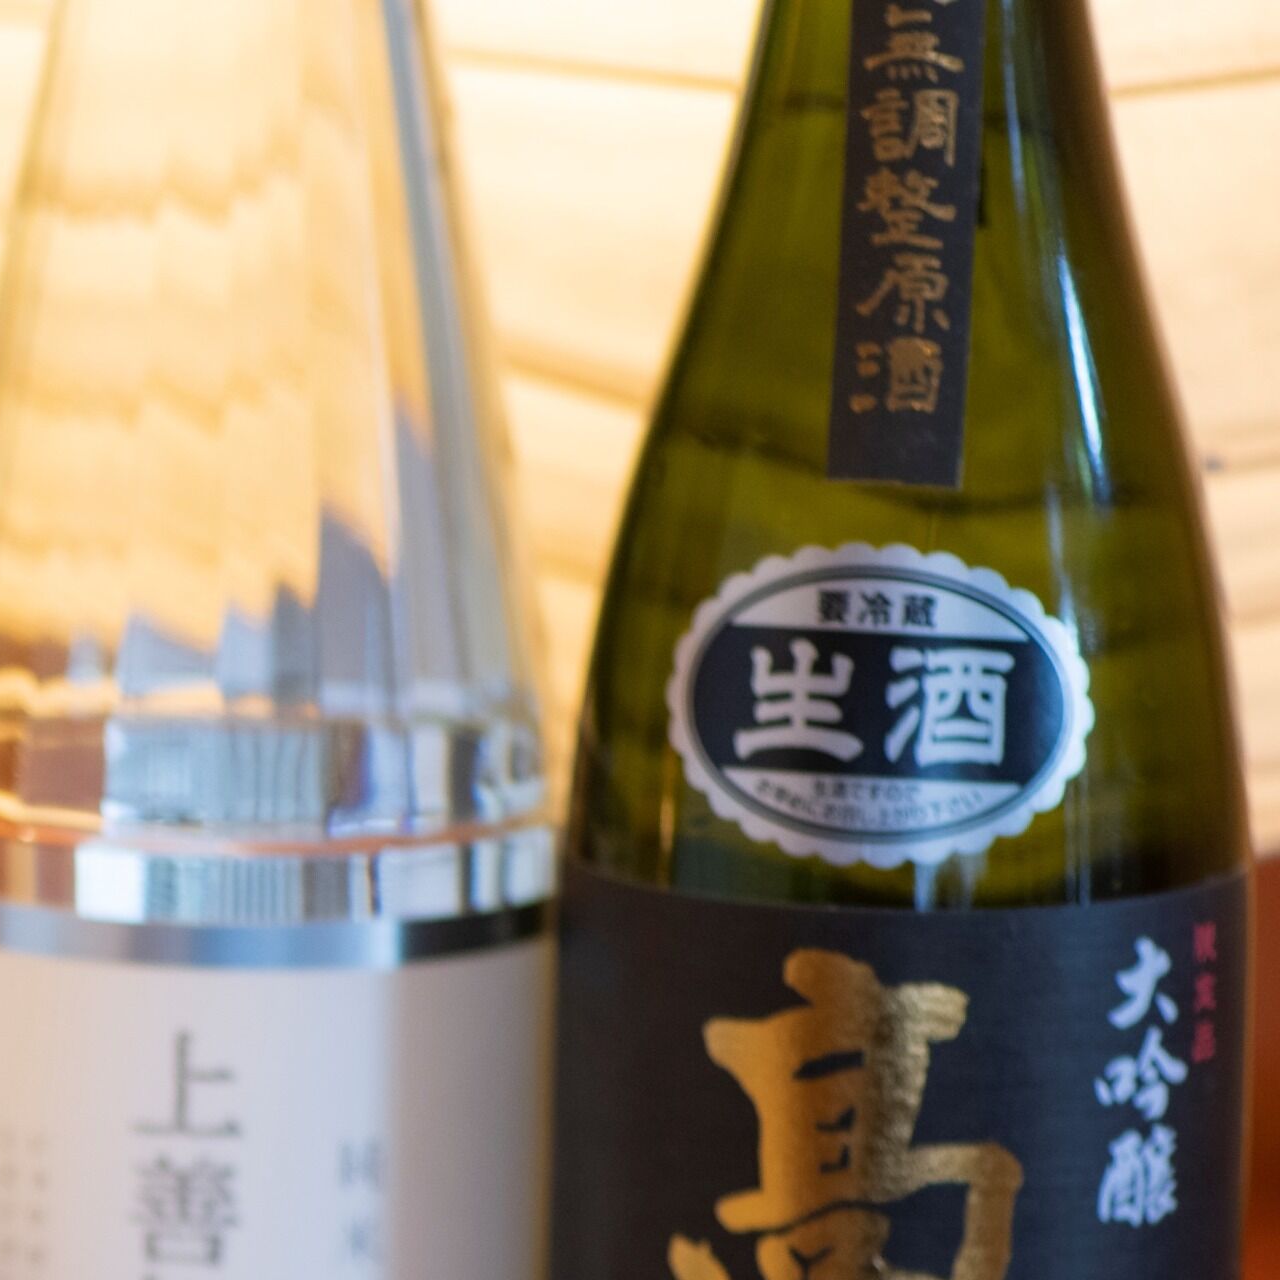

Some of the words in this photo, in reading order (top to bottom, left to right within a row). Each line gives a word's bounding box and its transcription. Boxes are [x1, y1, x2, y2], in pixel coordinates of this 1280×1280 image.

[850, 4, 966, 414] 無調整原酒
[732, 636, 1016, 769] 生酒
[818, 588, 938, 628] 要冷蔵
[1093, 935, 1189, 1228] 大吟醸
